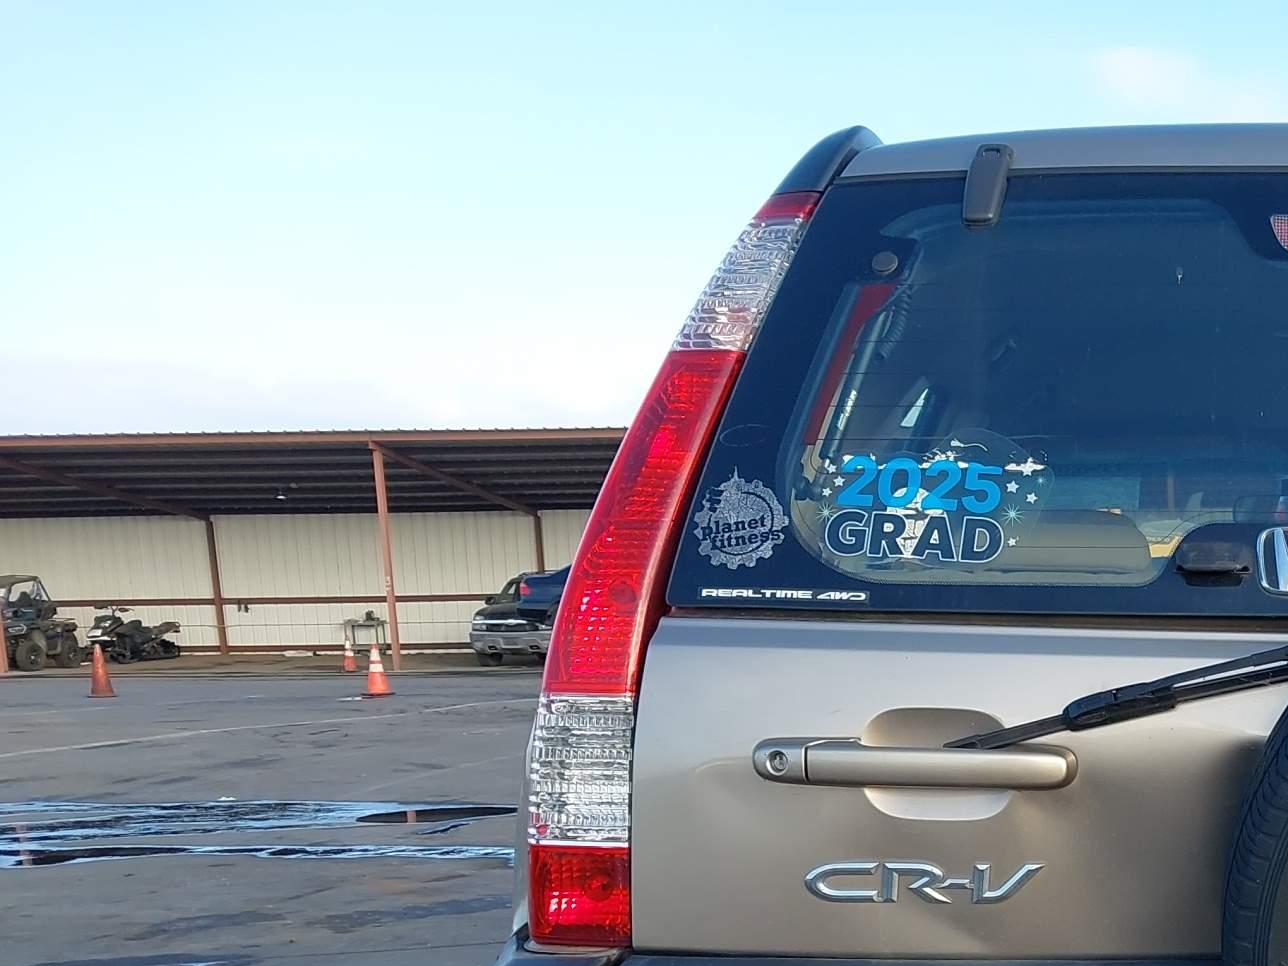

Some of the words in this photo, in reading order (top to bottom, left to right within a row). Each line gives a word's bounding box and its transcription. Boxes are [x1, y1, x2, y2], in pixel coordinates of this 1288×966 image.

[837, 454, 1003, 514] 2025
[701, 514, 768, 541] planet
[711, 529, 781, 551] fitness
[825, 508, 1004, 563] GRAD
[701, 588, 813, 599] REALTIME
[817, 591, 866, 601] 4WD
[804, 862, 1046, 904] CR-V
